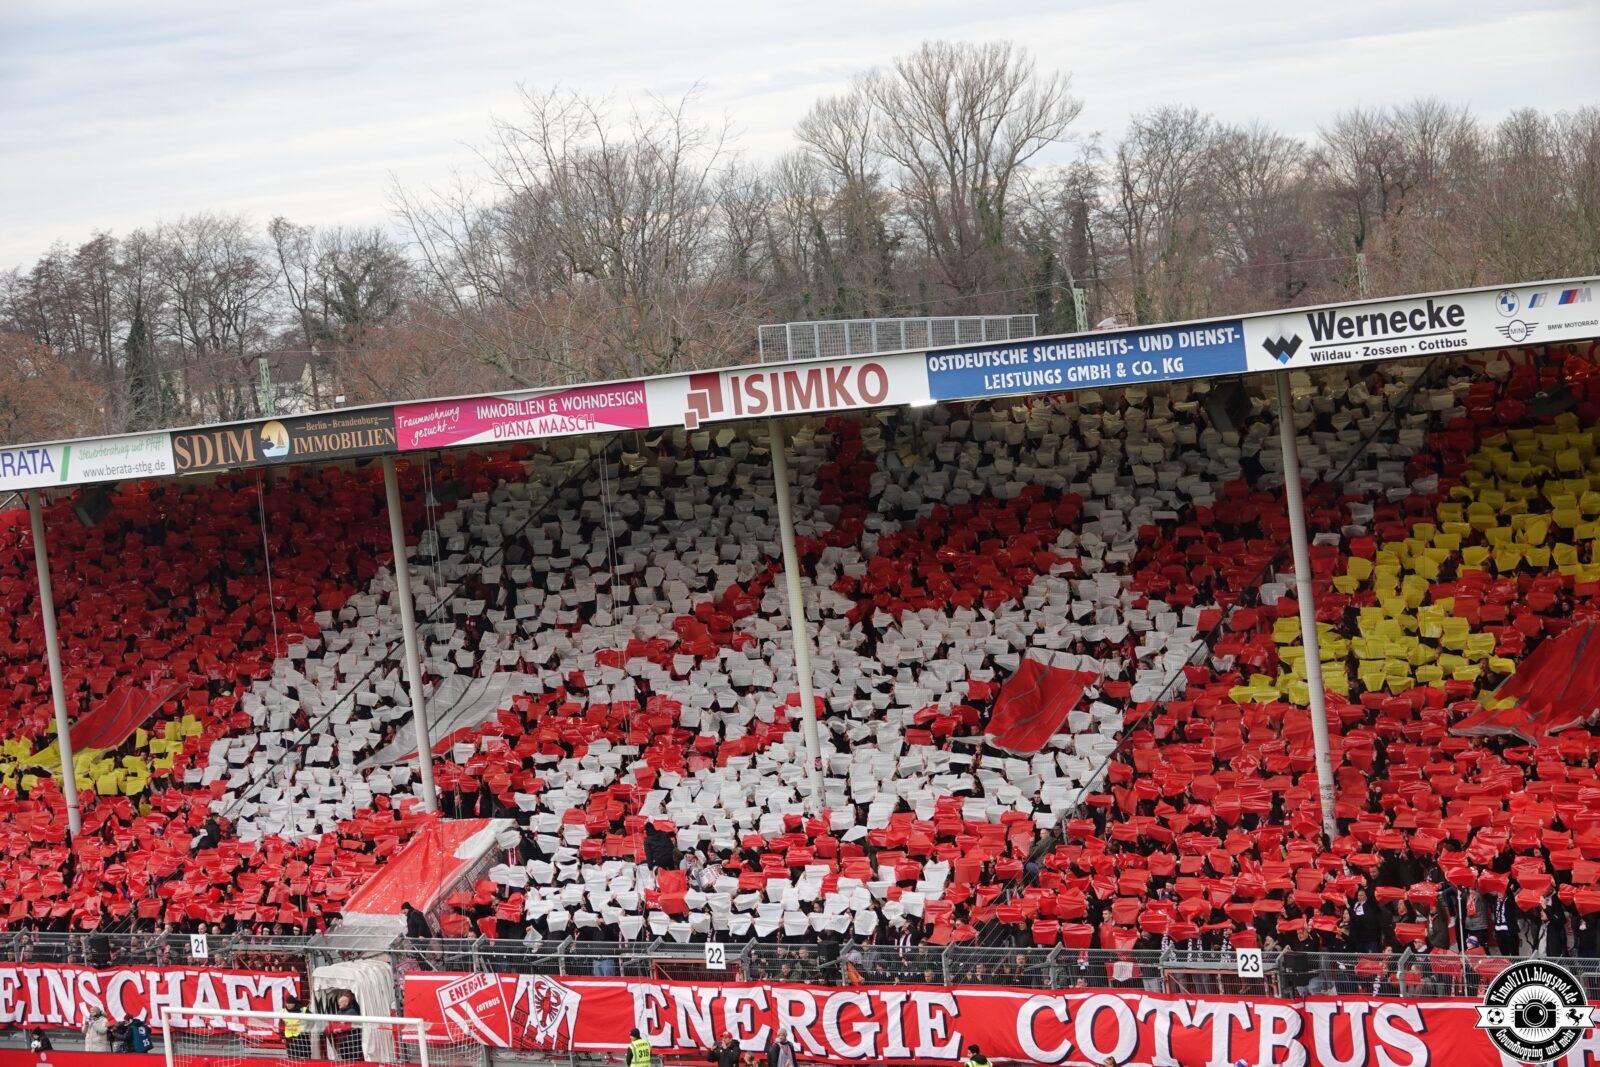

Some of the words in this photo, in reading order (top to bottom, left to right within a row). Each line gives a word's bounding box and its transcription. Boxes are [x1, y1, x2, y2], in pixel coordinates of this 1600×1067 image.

[1307, 300, 1466, 342] Wernecke
[1564, 320, 1599, 329] MOTORRAD
[928, 347, 1029, 372] OSTDEUTSCHE
[1033, 339, 1134, 363] SICHERHEITS-
[1138, 334, 1174, 352] UND
[1179, 328, 1241, 348] DIENST-
[1310, 348, 1352, 363] Wildau
[1362, 343, 1408, 357] Zossen
[1418, 337, 1468, 352] Cottbus
[984, 370, 1062, 391] LEISTUNGS
[1067, 364, 1112, 382] GMBH
[1116, 362, 1127, 378] &
[1131, 361, 1158, 377] CO.
[1162, 357, 1184, 374] KG
[731, 363, 889, 416] ISIMKO
[398, 406, 460, 429] Traumwohnung
[476, 399, 545, 420] IMMOBILIEN
[548, 399, 558, 413] &
[561, 390, 644, 411] WOHNDESIGN
[293, 426, 397, 455] IMMOBILIEN
[493, 420, 534, 439] DIANA
[538, 414, 596, 437] MAASCH
[0, 448, 55, 479] RATA
[173, 428, 258, 470] SDIM
[83, 459, 166, 478] www.berata-stbg.de
[194, 938, 206, 954] 21
[707, 947, 724, 965] 22
[1239, 953, 1259, 973] 23
[449, 973, 488, 1002] ENERGIE
[476, 996, 501, 1013] COTTBUS
[627, 984, 963, 1062] ENERGIE
[1016, 993, 1432, 1067] COTTBUS
